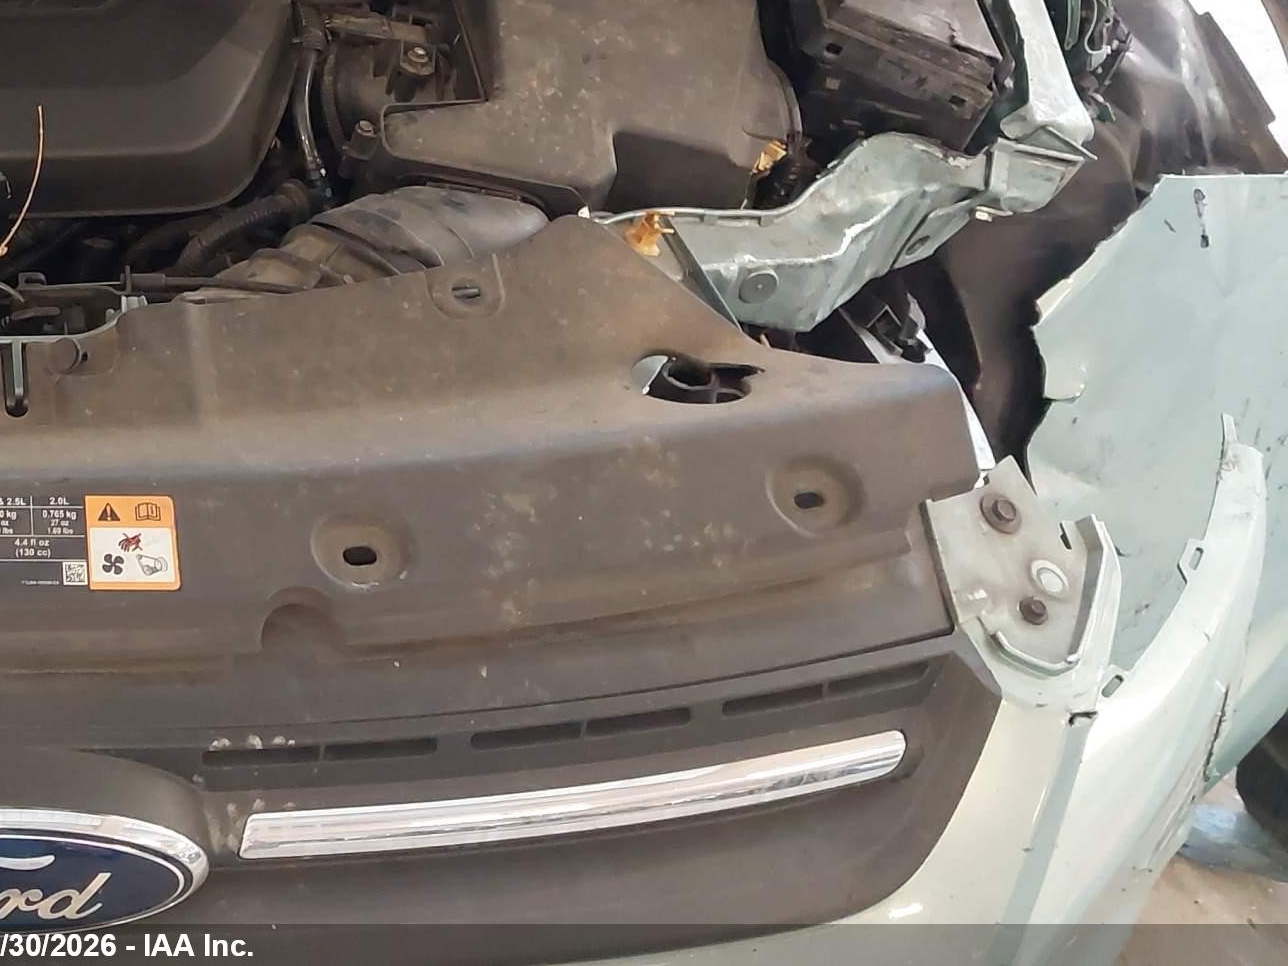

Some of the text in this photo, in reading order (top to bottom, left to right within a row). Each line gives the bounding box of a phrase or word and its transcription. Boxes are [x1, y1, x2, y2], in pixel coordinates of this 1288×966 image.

[6, 497, 27, 506] 2.5L
[49, 496, 69, 505] 2.0L
[6, 509, 17, 520] kg
[66, 510, 77, 520] kg
[15, 548, 51, 558] (130 cc)
